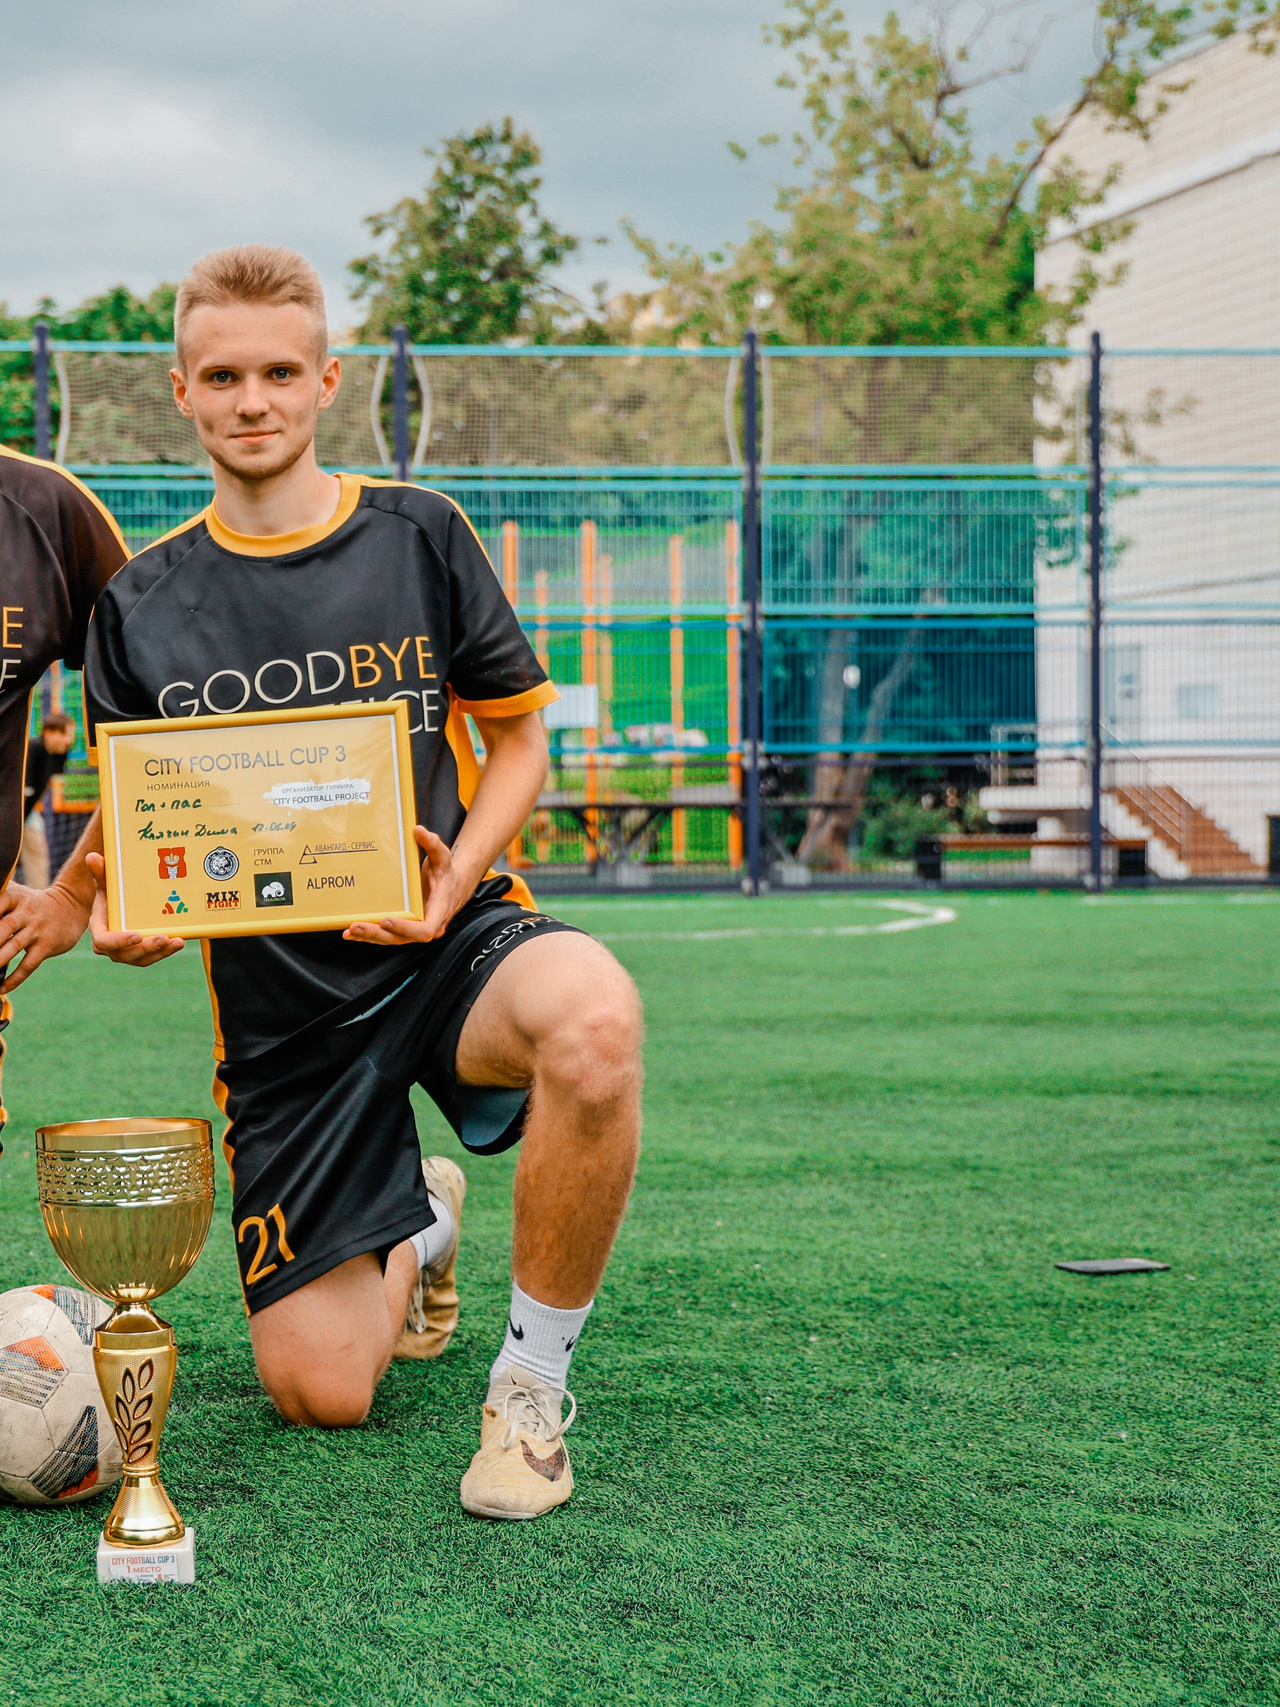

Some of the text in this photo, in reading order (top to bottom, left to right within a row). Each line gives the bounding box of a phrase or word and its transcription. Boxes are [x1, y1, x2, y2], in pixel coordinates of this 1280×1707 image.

[158, 636, 438, 719] GOODBYE
[144, 745, 347, 776] CITY FOOTBALL CUP 3
[146, 780, 210, 792] НОМИНАЦИЯ
[281, 783, 354, 794] ОРГАНИЗАТОР ТУРНИРА
[272, 791, 370, 806] CITY FOOTBALL PROJECT
[253, 847, 285, 856] ГРУППА
[253, 858, 272, 867] СТМ
[306, 875, 355, 890] ALPROM
[206, 890, 239, 902] MIX
[206, 899, 240, 909] FIGHT
[238, 1203, 295, 1286] 21
[112, 1557, 126, 1566] CITY
[126, 1555, 157, 1565] FOOTBALL
[157, 1555, 170, 1564] CUP
[133, 1566, 162, 1574] МЕСТО
